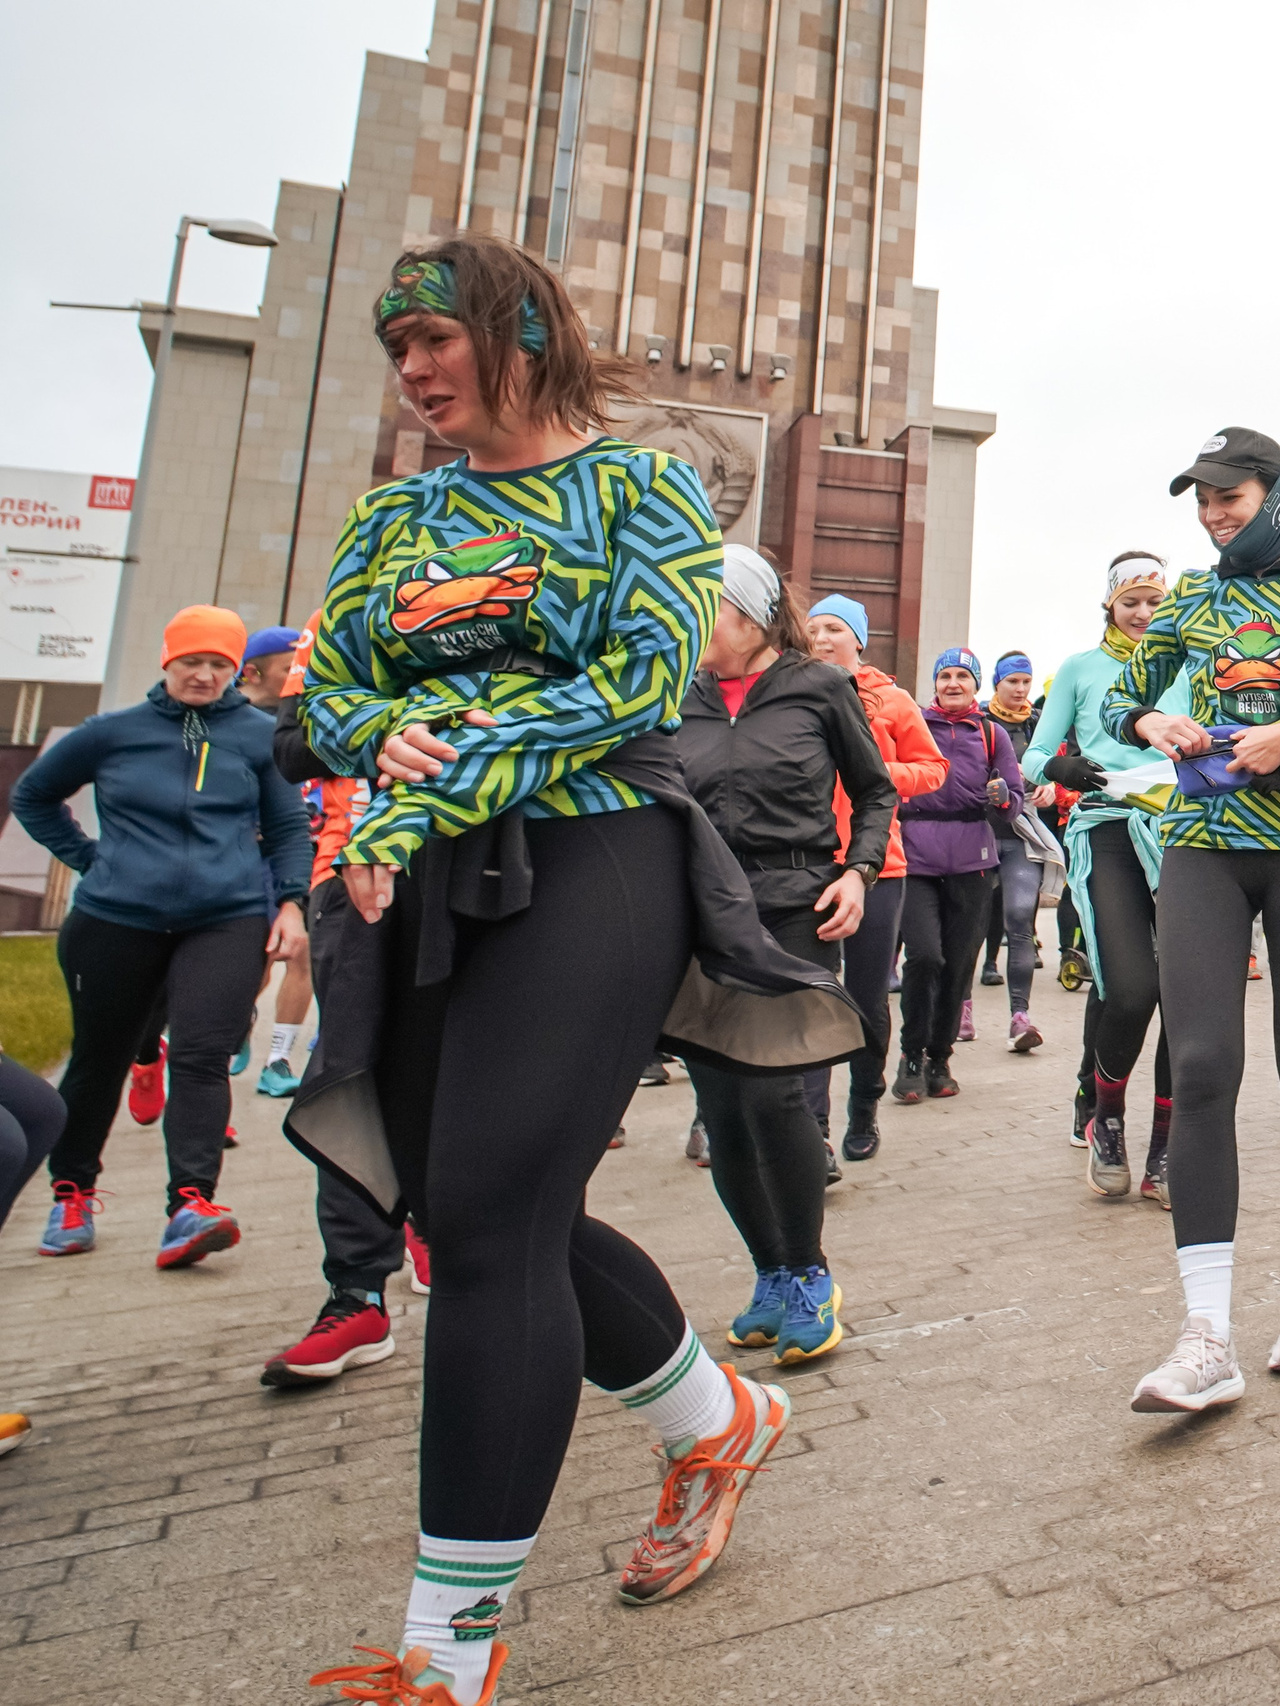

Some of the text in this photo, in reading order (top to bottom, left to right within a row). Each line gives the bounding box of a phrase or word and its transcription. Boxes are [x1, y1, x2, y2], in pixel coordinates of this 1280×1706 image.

[431, 622, 500, 645] MYTISCHI
[1236, 692, 1275, 702] MYTISCHI
[1237, 701, 1278, 714] BEGOOD
